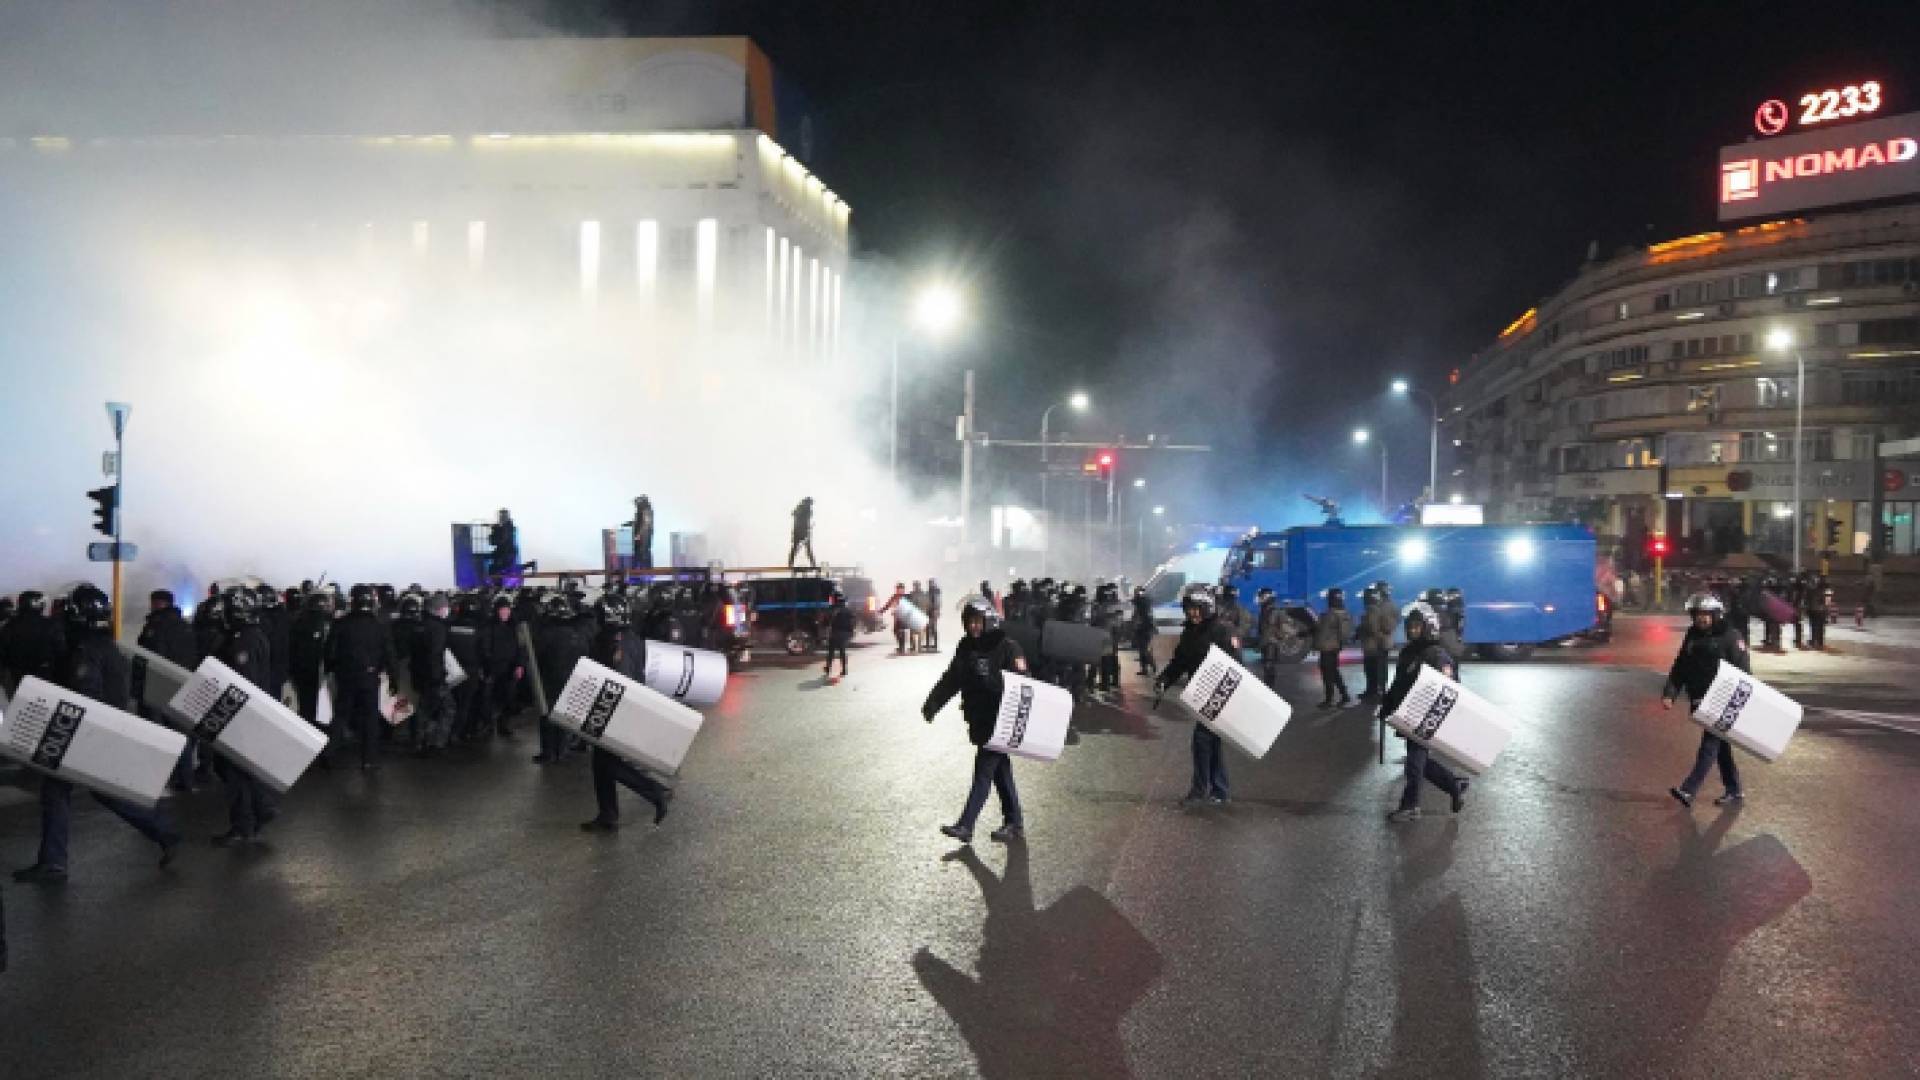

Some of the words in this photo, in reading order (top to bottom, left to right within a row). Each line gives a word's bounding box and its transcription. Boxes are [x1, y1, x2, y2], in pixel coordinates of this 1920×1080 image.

[1799, 81, 1880, 124] 2233
[1765, 138, 1917, 181] NOMAD
[582, 679, 624, 736] POLICE
[1201, 668, 1241, 720] POLICE
[1416, 687, 1456, 738] POLICE
